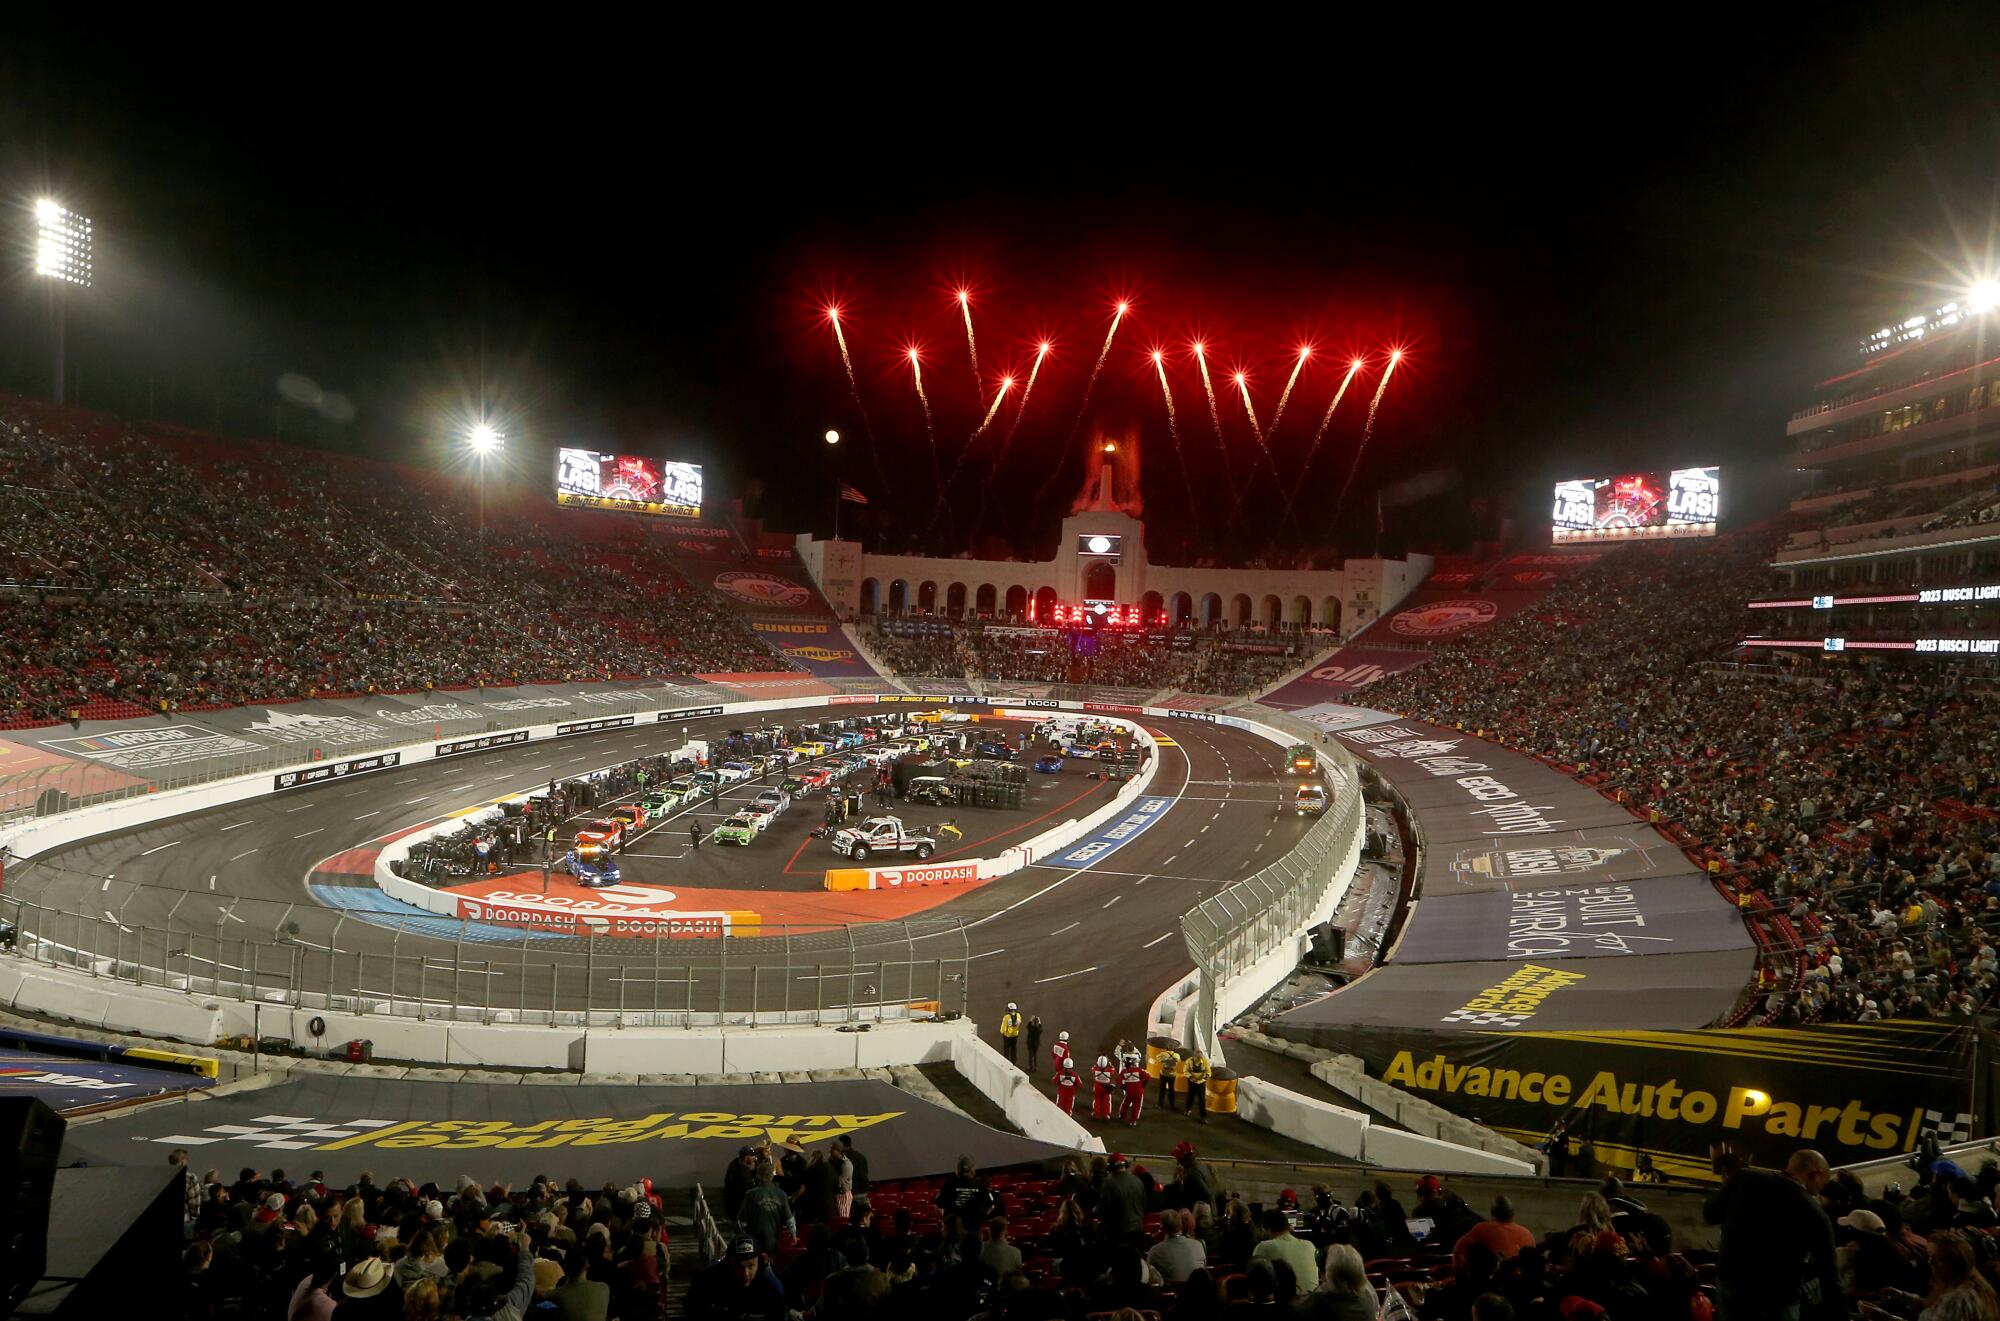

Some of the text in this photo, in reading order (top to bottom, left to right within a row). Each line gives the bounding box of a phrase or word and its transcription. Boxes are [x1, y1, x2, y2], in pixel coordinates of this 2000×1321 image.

[564, 496, 600, 507] SUNOCO
[615, 502, 649, 512] SUNOCO
[662, 506, 694, 516] SUNOCO
[1919, 590, 1941, 602] 2023
[1942, 588, 1973, 601] BUSCH
[752, 623, 828, 633] SUNOCO
[784, 648, 854, 657] SUNOCO
[1915, 639, 2000, 653] 2023 BUSCH LIGHT
[1311, 664, 1392, 688] ally
[1027, 699, 1058, 707] NOCO
[105, 729, 195, 748] NASCAR
[280, 773, 296, 785] BUSCH
[334, 763, 349, 774] BUSCH
[383, 754, 396, 765] BUSCH
[1469, 800, 1567, 834] xfinity
[1064, 841, 1112, 861] GEICO
[1506, 849, 1561, 876] CLASH
[907, 867, 973, 883] DOORDASH
[1512, 885, 1632, 899] HOMES
[485, 907, 575, 930] DOORDASH
[1578, 894, 1646, 927] BUILT
[617, 919, 719, 933] DOORDASH
[1501, 963, 1552, 986] Auto
[1501, 969, 1587, 1011] Advance
[15, 1072, 137, 1090] FOX
[1382, 1050, 1902, 1151] Advance Auto Parts
[417, 1111, 907, 1136] Auto Parts
[374, 1123, 861, 1149] Advance
